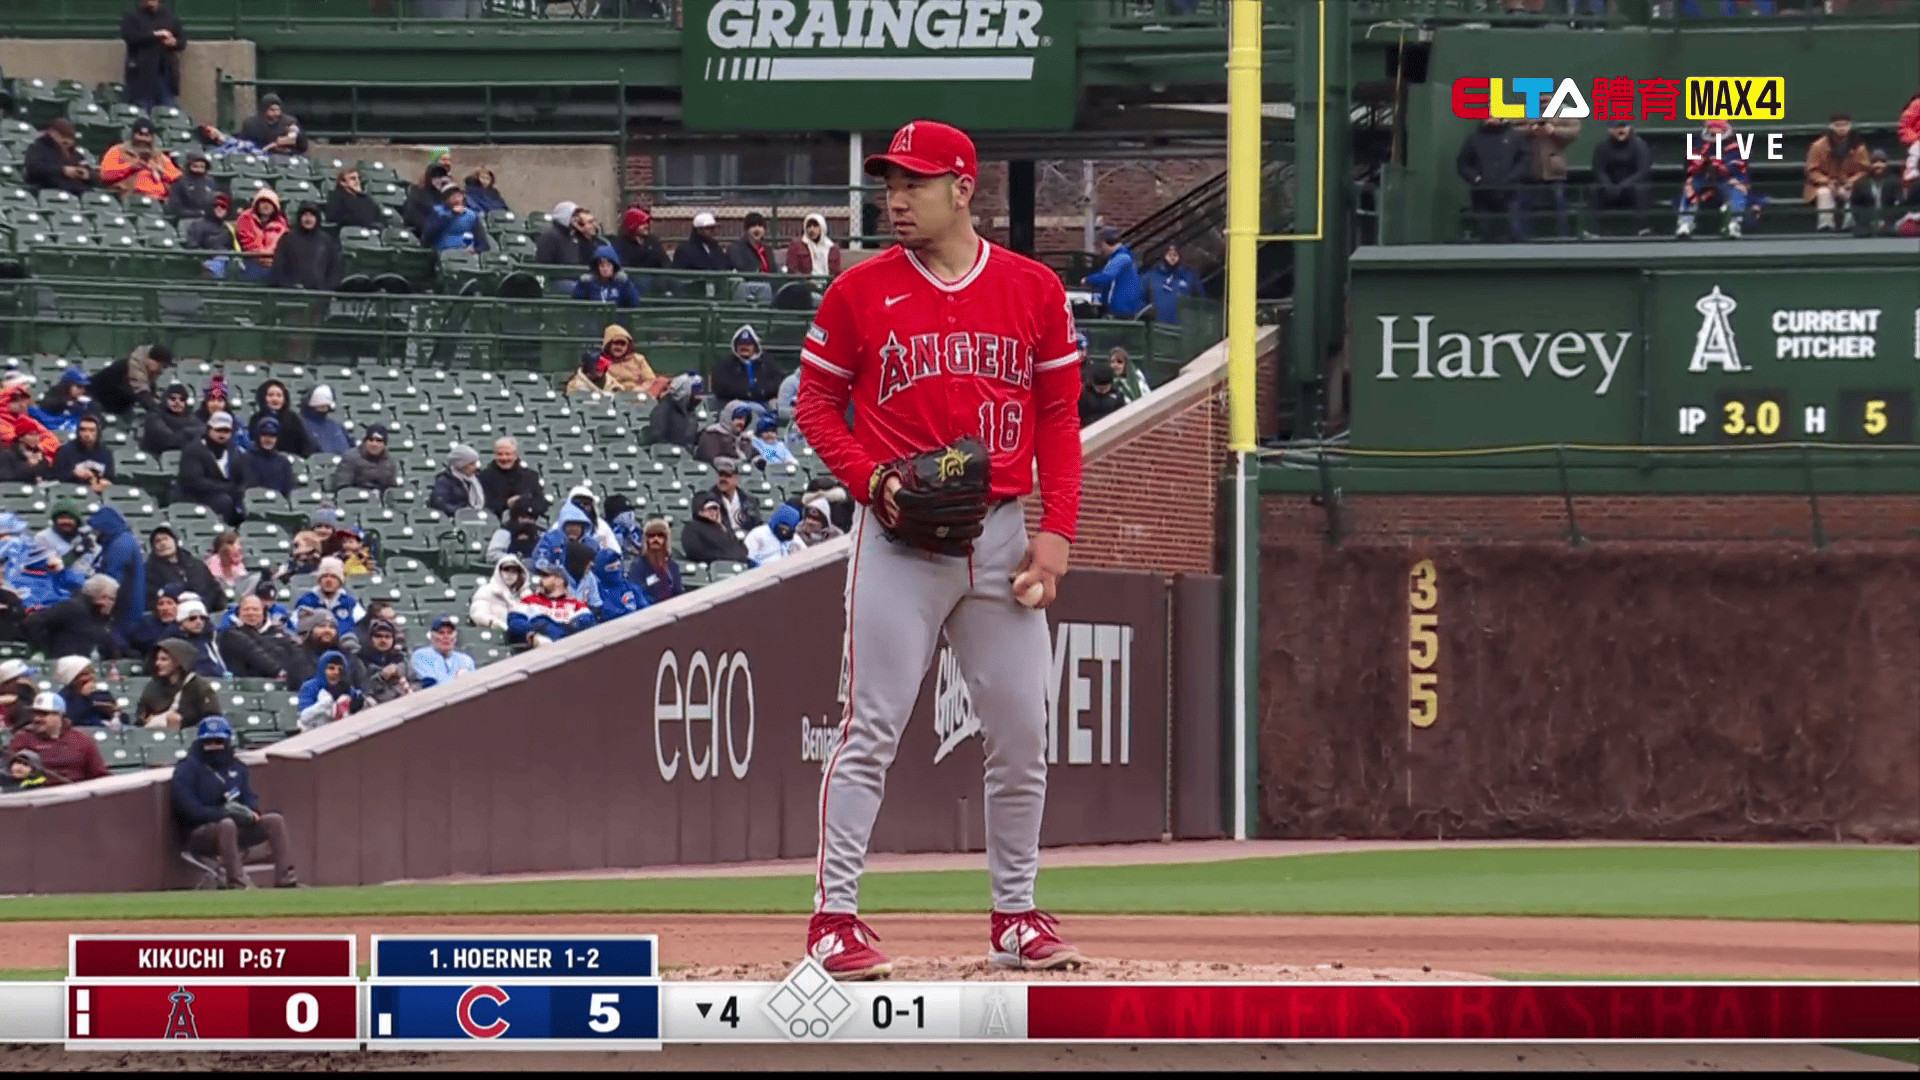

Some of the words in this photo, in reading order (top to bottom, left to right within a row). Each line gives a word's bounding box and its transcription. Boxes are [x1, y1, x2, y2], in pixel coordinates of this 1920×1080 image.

[707, 0, 1042, 49] GRAINGER
[1772, 309, 1882, 333] CURRENT
[1776, 335, 1876, 359] PITCHER
[878, 330, 1033, 405] ANGELS
[1376, 315, 1633, 395] Harvey
[979, 400, 1023, 453] 16
[1679, 406, 1707, 434] IP
[1722, 400, 1781, 435] 3.0
[1804, 406, 1826, 433] H
[1863, 400, 1888, 435] 5
[1408, 558, 1439, 728] 355
[654, 649, 755, 783] eero
[1047, 622, 1134, 765] YETI
